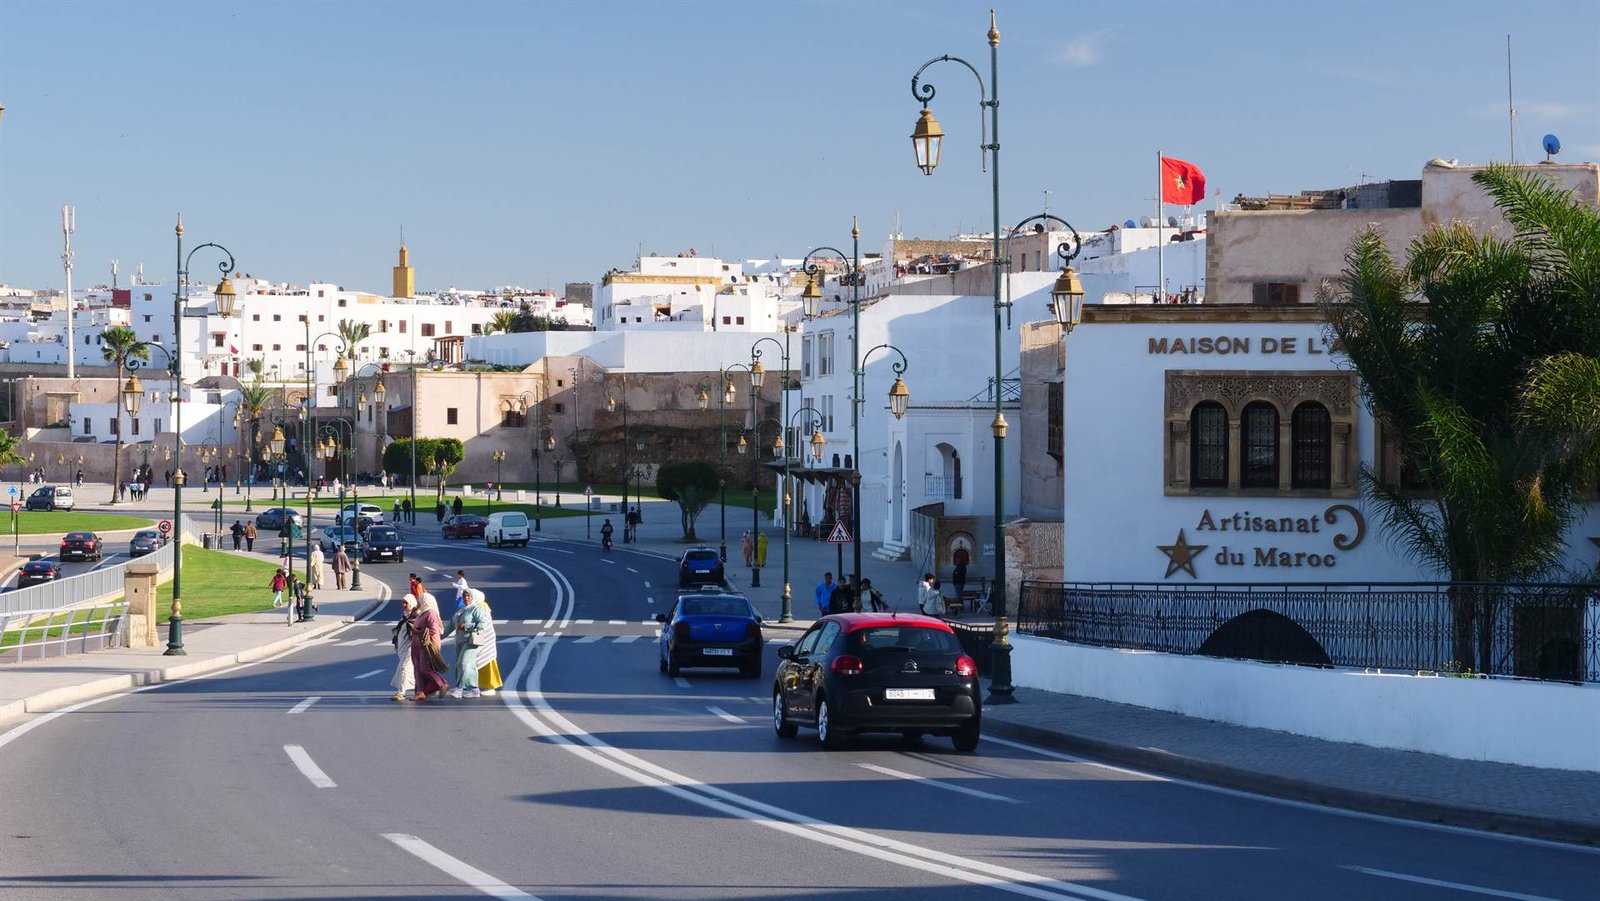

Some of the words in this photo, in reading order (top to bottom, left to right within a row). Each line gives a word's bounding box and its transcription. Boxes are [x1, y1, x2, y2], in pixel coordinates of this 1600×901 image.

[1148, 336, 1250, 355] MAISON
[1261, 337, 1297, 355] DE
[1195, 508, 1320, 533] Artisanat
[1214, 546, 1245, 566] du
[1253, 547, 1337, 568] Maroc
